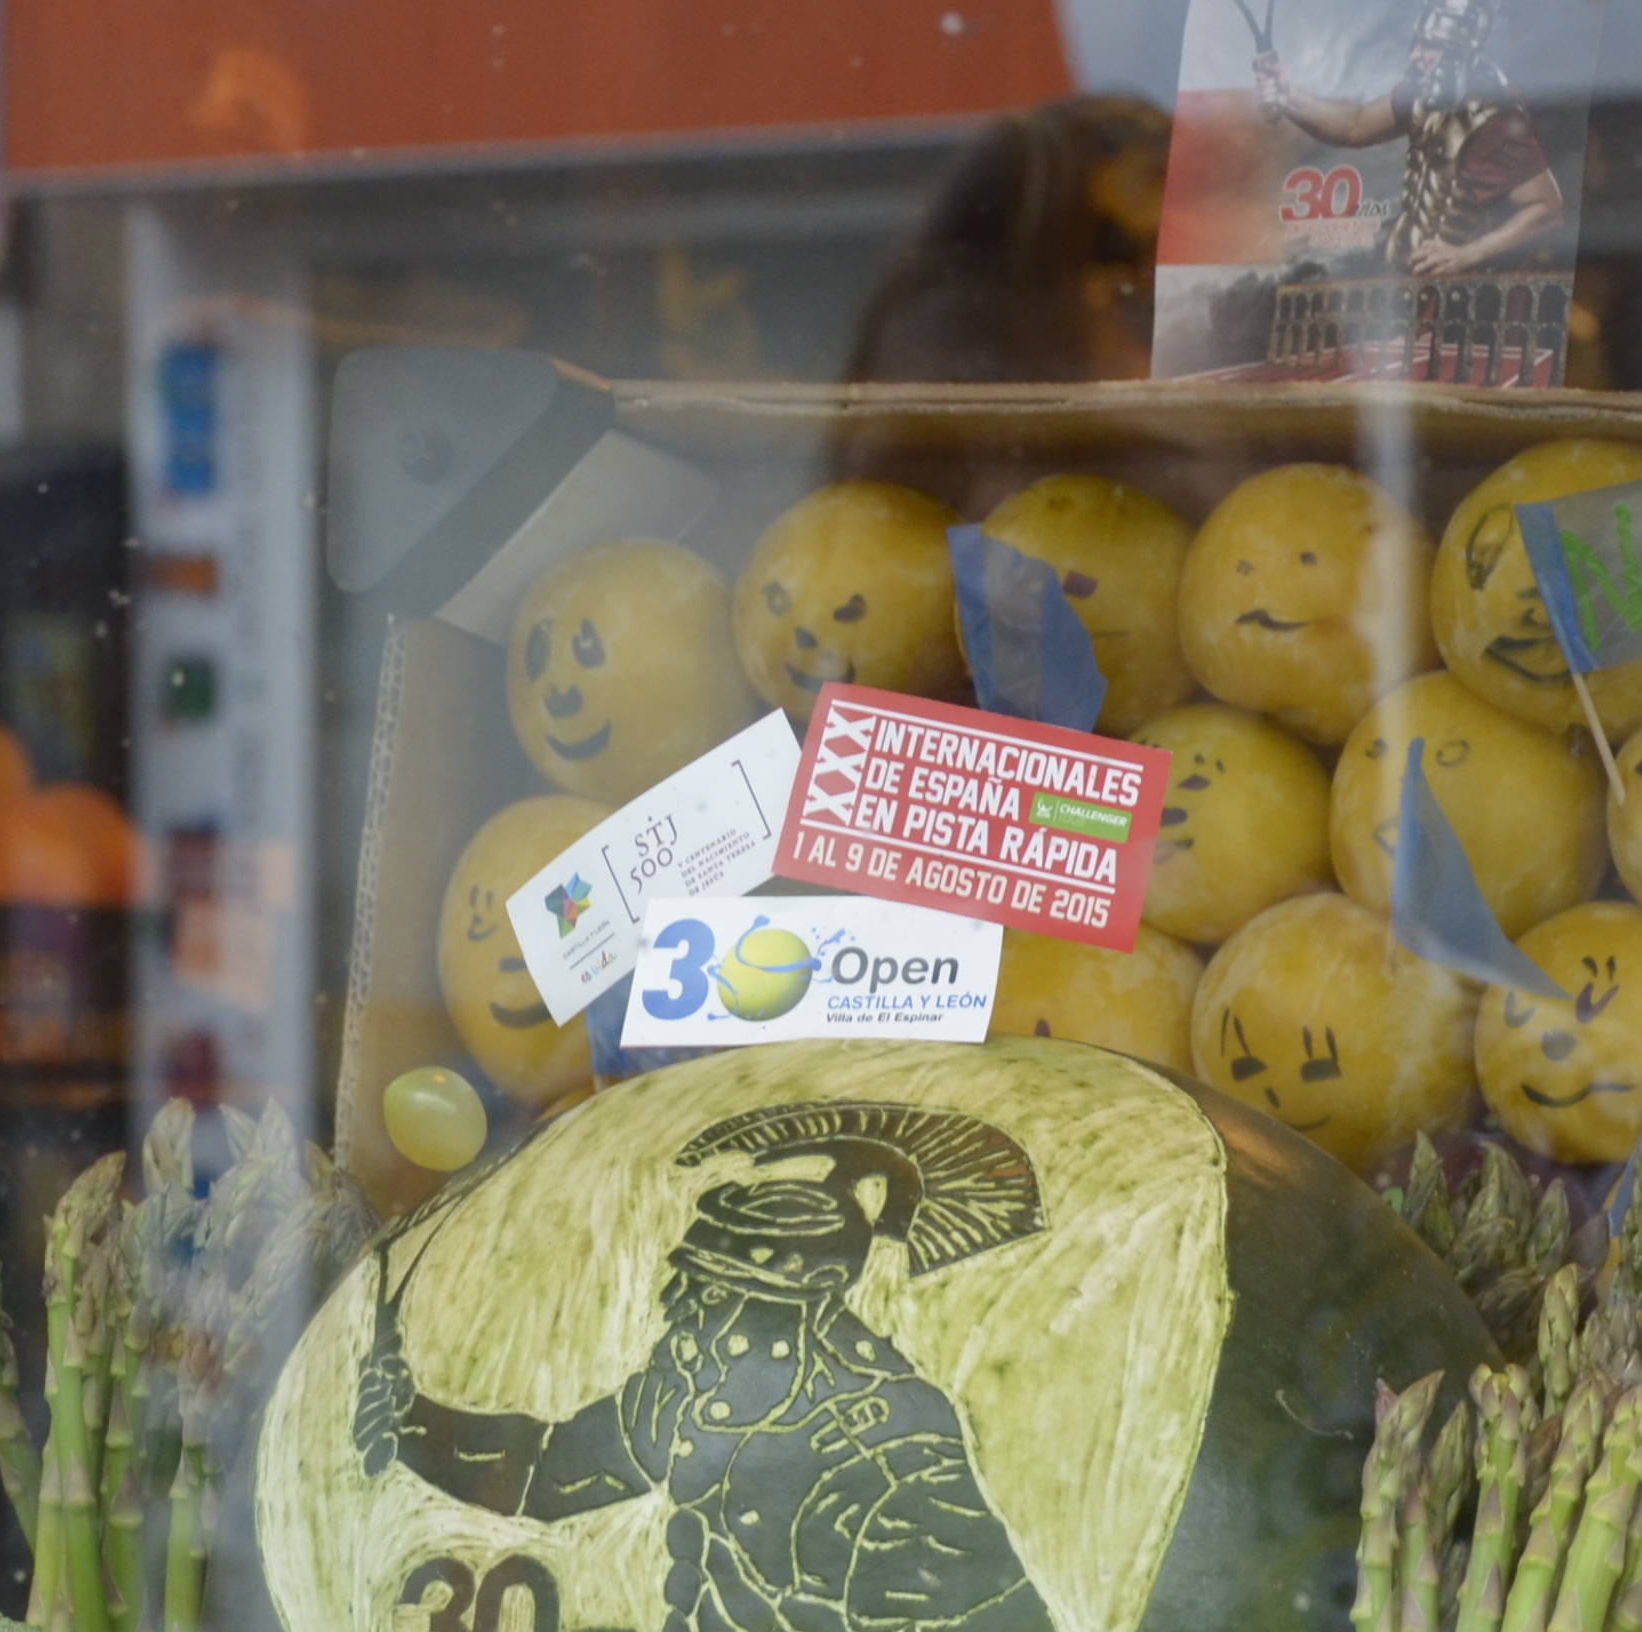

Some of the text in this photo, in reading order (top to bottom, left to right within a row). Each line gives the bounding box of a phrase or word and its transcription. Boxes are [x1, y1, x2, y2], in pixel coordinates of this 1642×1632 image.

[1280, 166, 1361, 220] 30
[874, 719, 1142, 807] INTERNACIONALES
[865, 757, 1020, 821] DE ESPAÑA
[1059, 803, 1128, 827] CHALLENGER
[685, 828, 737, 865] CENTENARIO
[698, 831, 750, 868] NACIMIENTO
[855, 793, 1117, 884] EN PISTA RÁPIDA
[698, 860, 724, 880] SANTA
[793, 831, 1112, 929] 1 AL 9 DE AGOSTO DE 2015
[831, 946, 959, 994] Open
[826, 1011, 943, 1024] Villa de El Espinar
[827, 991, 988, 1010] CASTILLA Y LEÓN
